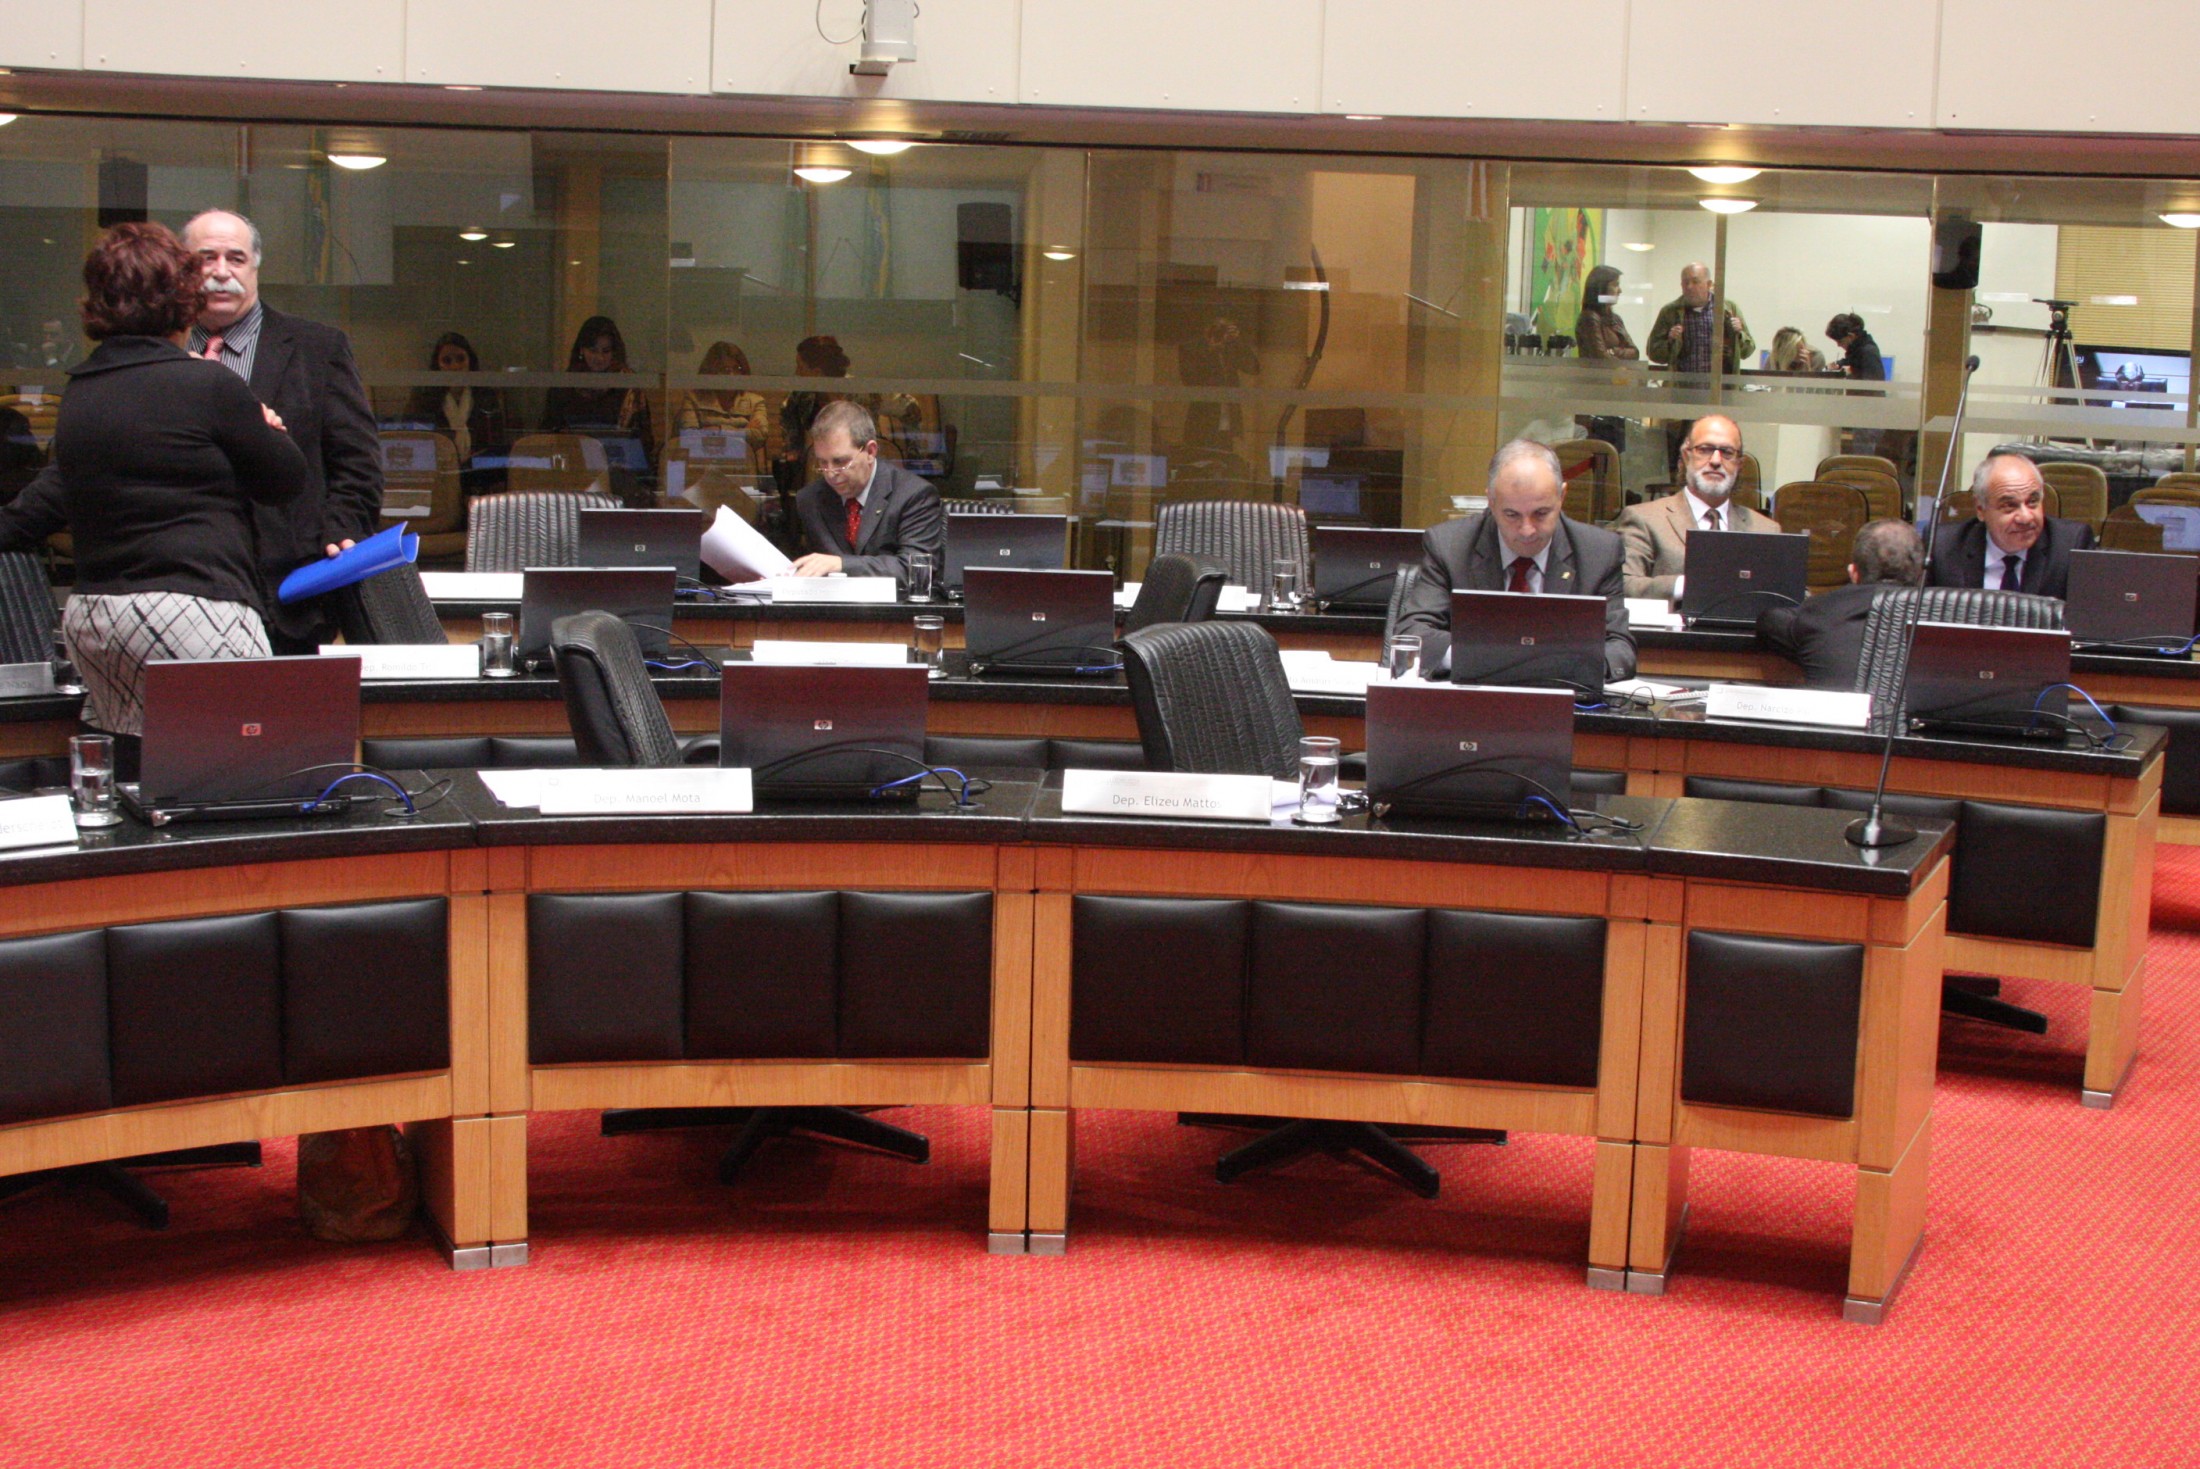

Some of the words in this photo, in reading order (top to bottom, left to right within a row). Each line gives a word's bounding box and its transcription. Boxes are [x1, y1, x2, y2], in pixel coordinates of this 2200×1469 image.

[626, 793, 668, 804] Manoel
[672, 793, 701, 804] Mota
[1112, 794, 1139, 808] Dep.
[1144, 795, 1180, 808] Elizeu
[1183, 797, 1222, 809] Mattos
